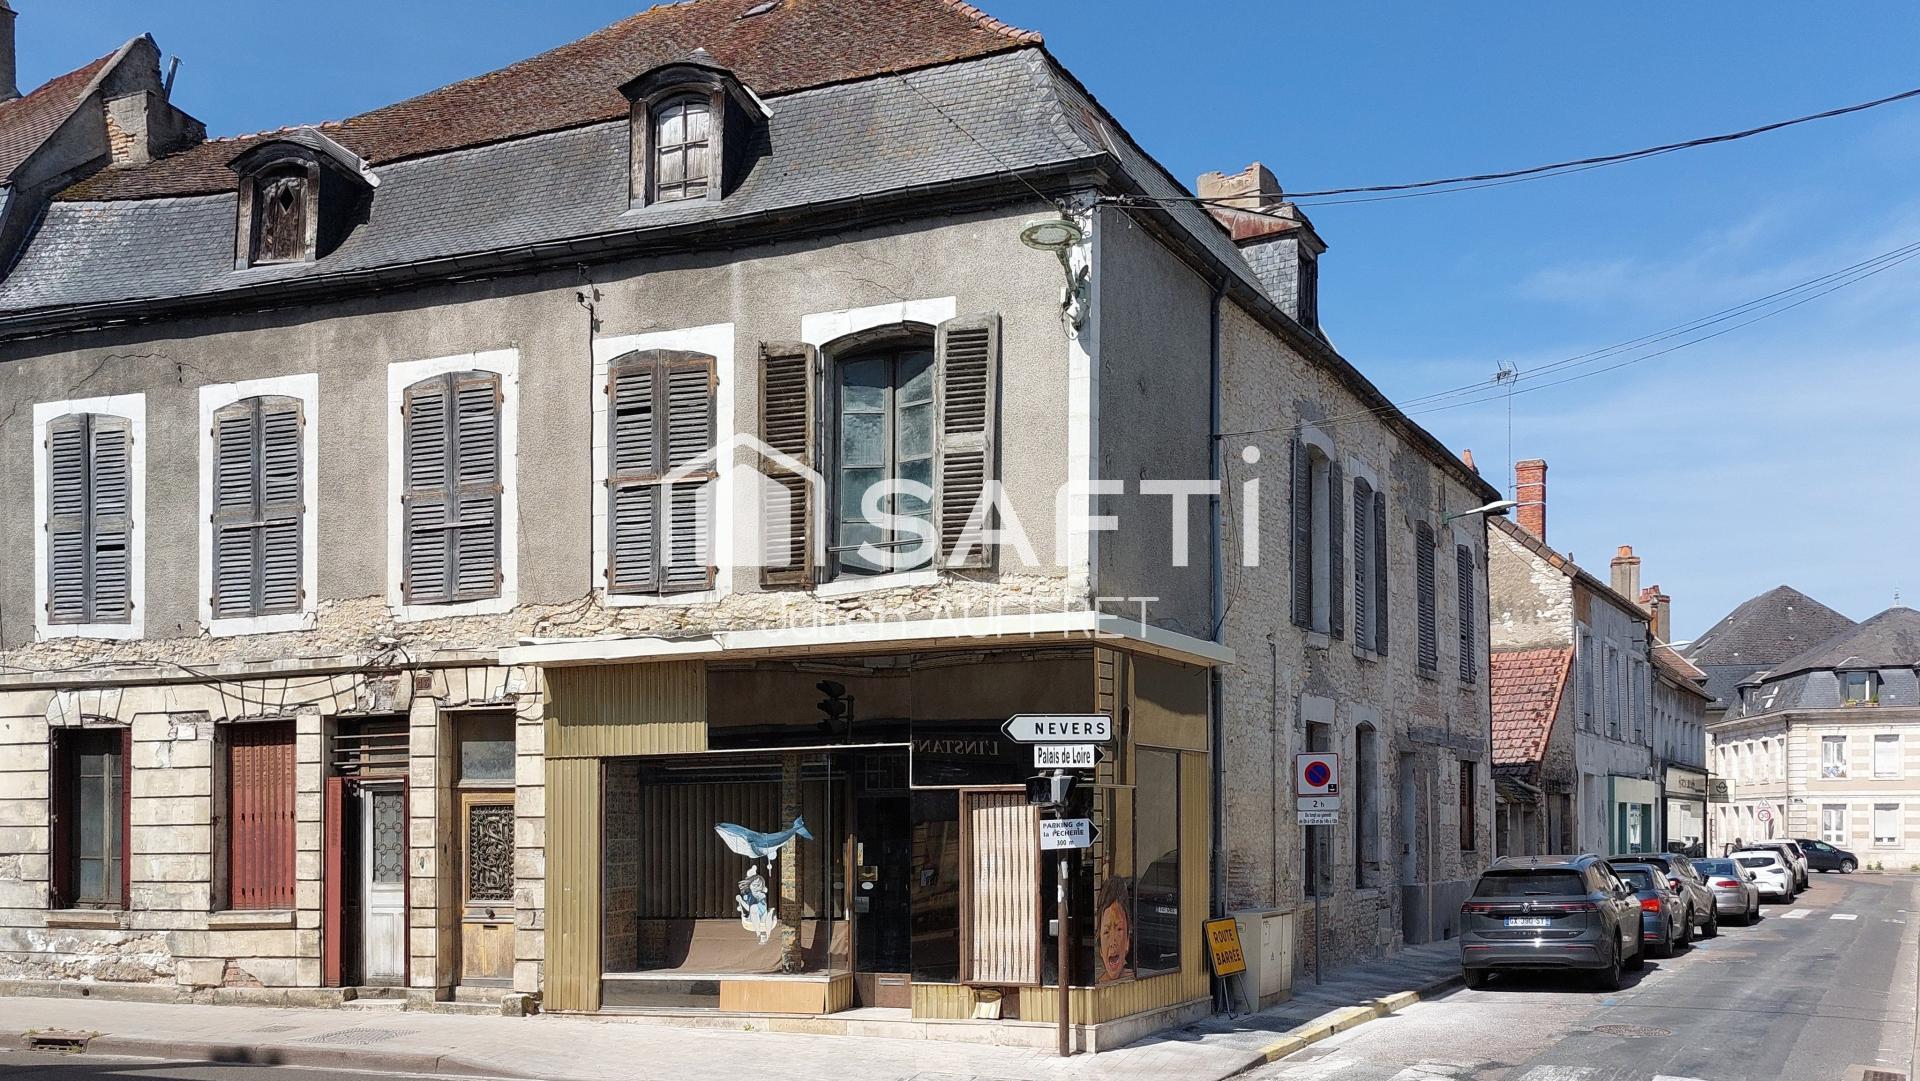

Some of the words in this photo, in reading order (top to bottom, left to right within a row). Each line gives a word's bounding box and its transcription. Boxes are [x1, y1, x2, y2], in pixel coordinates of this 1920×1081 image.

[1035, 722, 1105, 735] NEVERS
[1037, 747, 1060, 764] Palais
[1061, 747, 1070, 764] de
[1072, 747, 1091, 764] Loire
[1313, 800, 1318, 808] 2
[1042, 821, 1073, 829] PARKING
[1213, 929, 1234, 944] ROUTE
